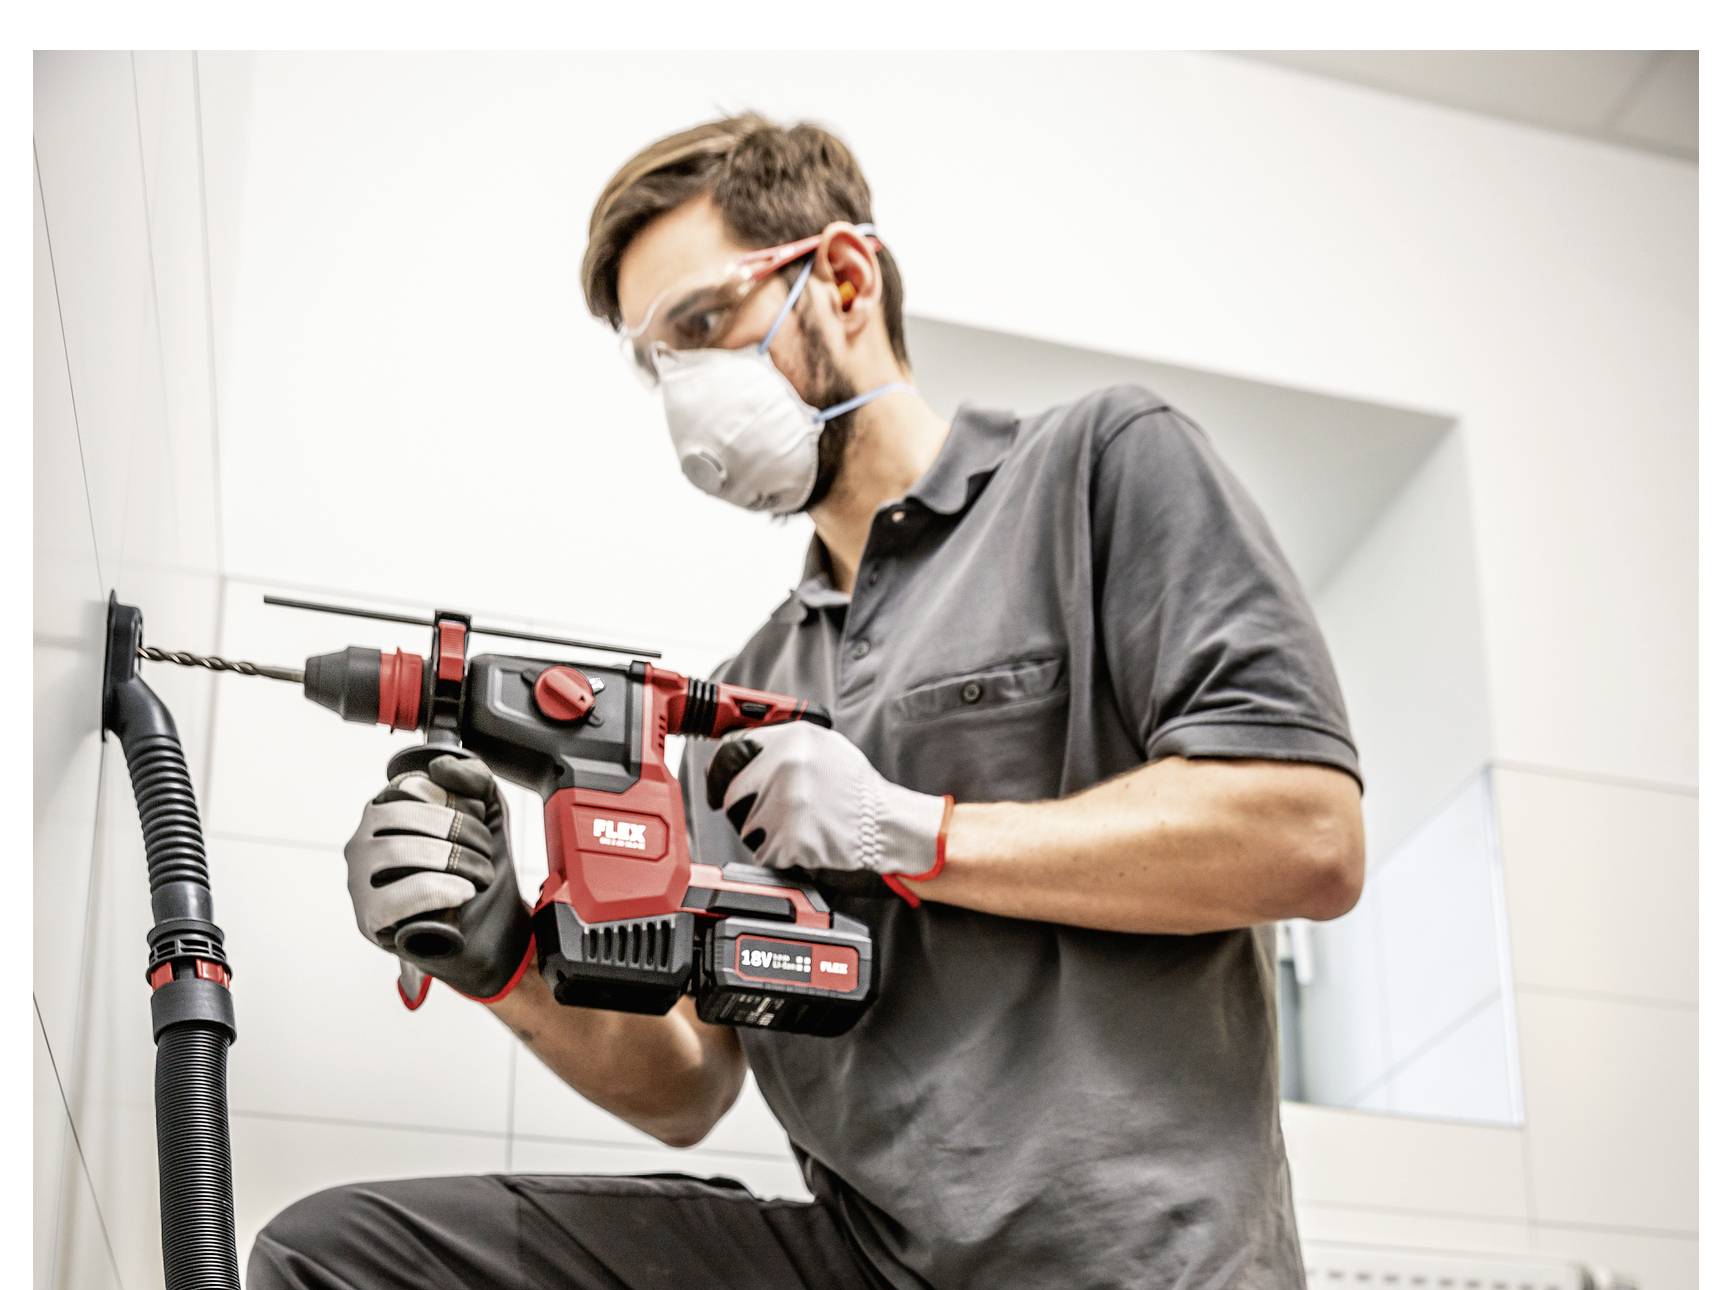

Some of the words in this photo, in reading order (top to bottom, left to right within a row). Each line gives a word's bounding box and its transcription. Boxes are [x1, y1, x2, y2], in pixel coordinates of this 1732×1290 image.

[593, 818, 647, 842] FLEX
[741, 949, 773, 969] 18V
[819, 960, 848, 975] FLEX
